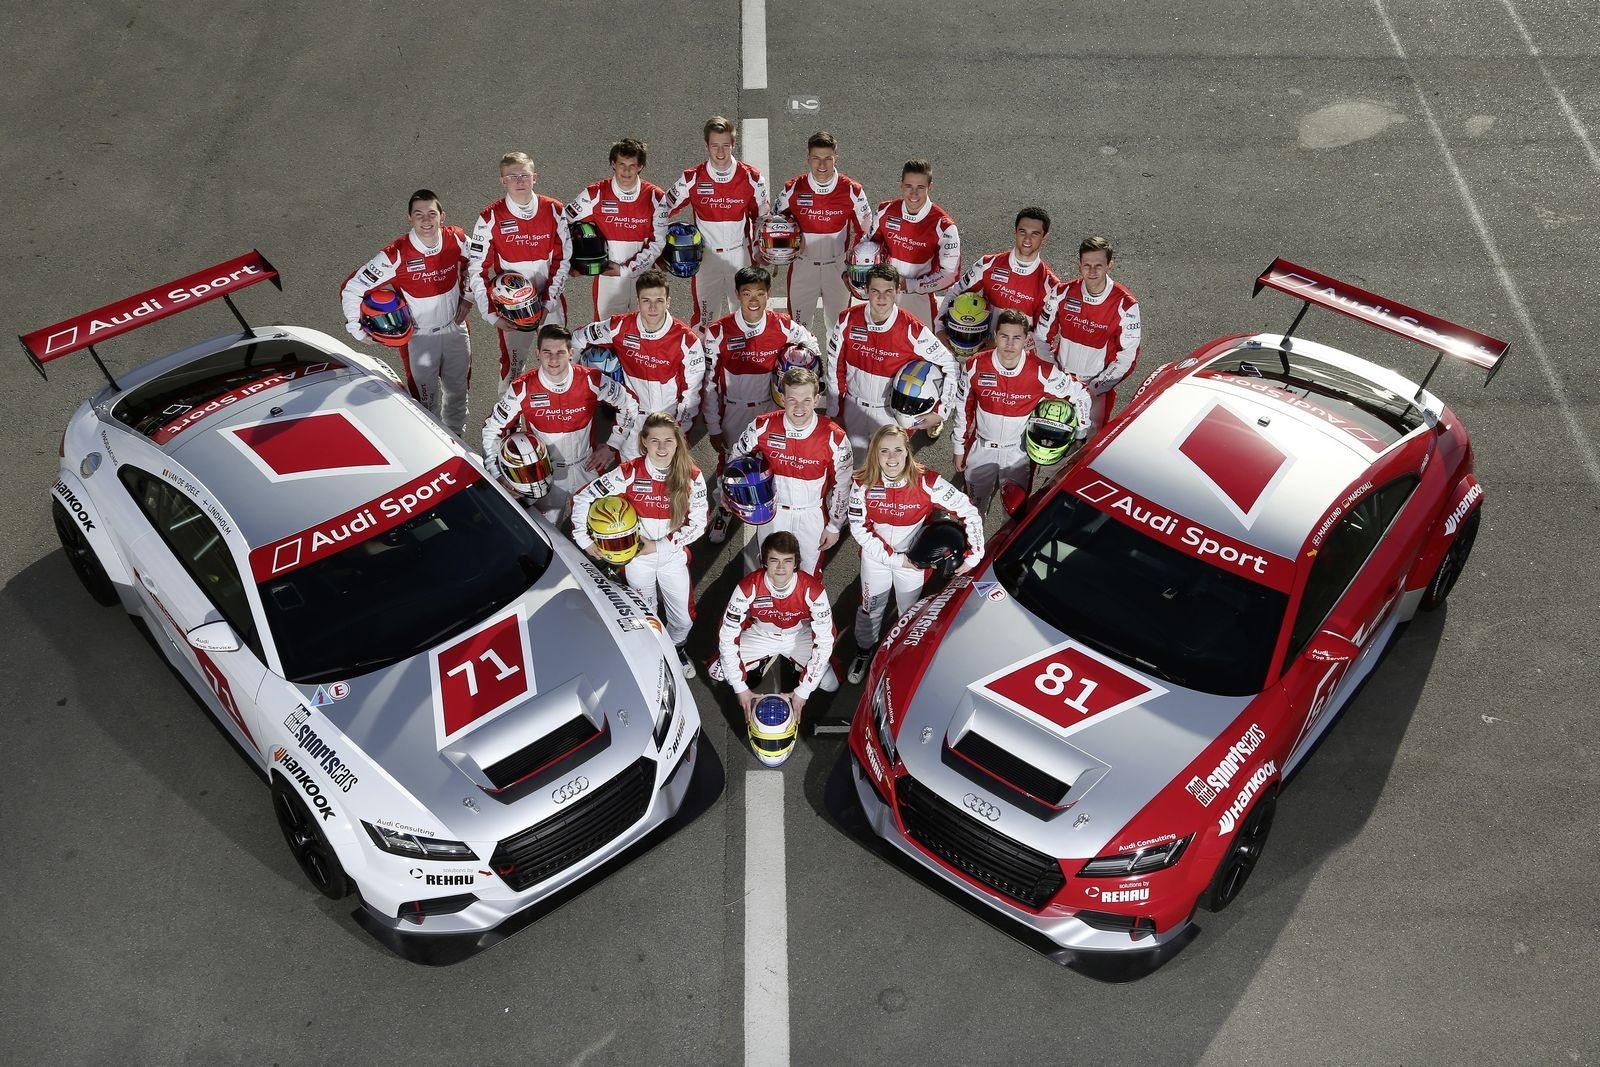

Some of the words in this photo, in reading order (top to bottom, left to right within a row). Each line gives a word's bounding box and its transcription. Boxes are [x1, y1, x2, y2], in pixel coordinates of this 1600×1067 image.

[894, 234, 908, 242] Audi
[908, 238, 927, 248] Sport
[422, 270, 438, 278] Audi
[440, 265, 456, 276] Sport
[89, 297, 162, 335] Audi
[167, 263, 260, 302] Sport
[1000, 286, 1016, 296] Audi
[1074, 316, 1089, 325] Audi
[1090, 322, 1108, 330] Sport
[1316, 287, 1391, 320] Audi
[1398, 316, 1490, 356] Spt
[651, 356, 670, 365] Sport
[861, 345, 878, 354] Audi
[879, 350, 899, 358] Sport
[242, 370, 297, 397] Audi
[1210, 374, 1280, 398] Sport
[168, 394, 236, 434] Sport
[565, 406, 586, 414] Sport
[1288, 398, 1346, 424] Audi
[168, 472, 178, 482] VAN
[208, 504, 232, 535] LINDHOLM
[312, 508, 378, 552] Audi
[380, 470, 456, 518] Sport
[1318, 507, 1342, 538] MARKLUND
[1110, 496, 1179, 536] Audi
[1180, 526, 1268, 574] Sport
[991, 591, 1003, 600] E
[446, 648, 520, 697] 71
[334, 685, 344, 696] E
[1034, 662, 1099, 714] 81
[866, 741, 882, 782] REHAU
[395, 823, 435, 837] Consulting
[1119, 844, 1135, 852] Audi
[1137, 833, 1176, 846] Consulting
[426, 875, 474, 885] REHAU
[1102, 888, 1149, 902] REHAU
